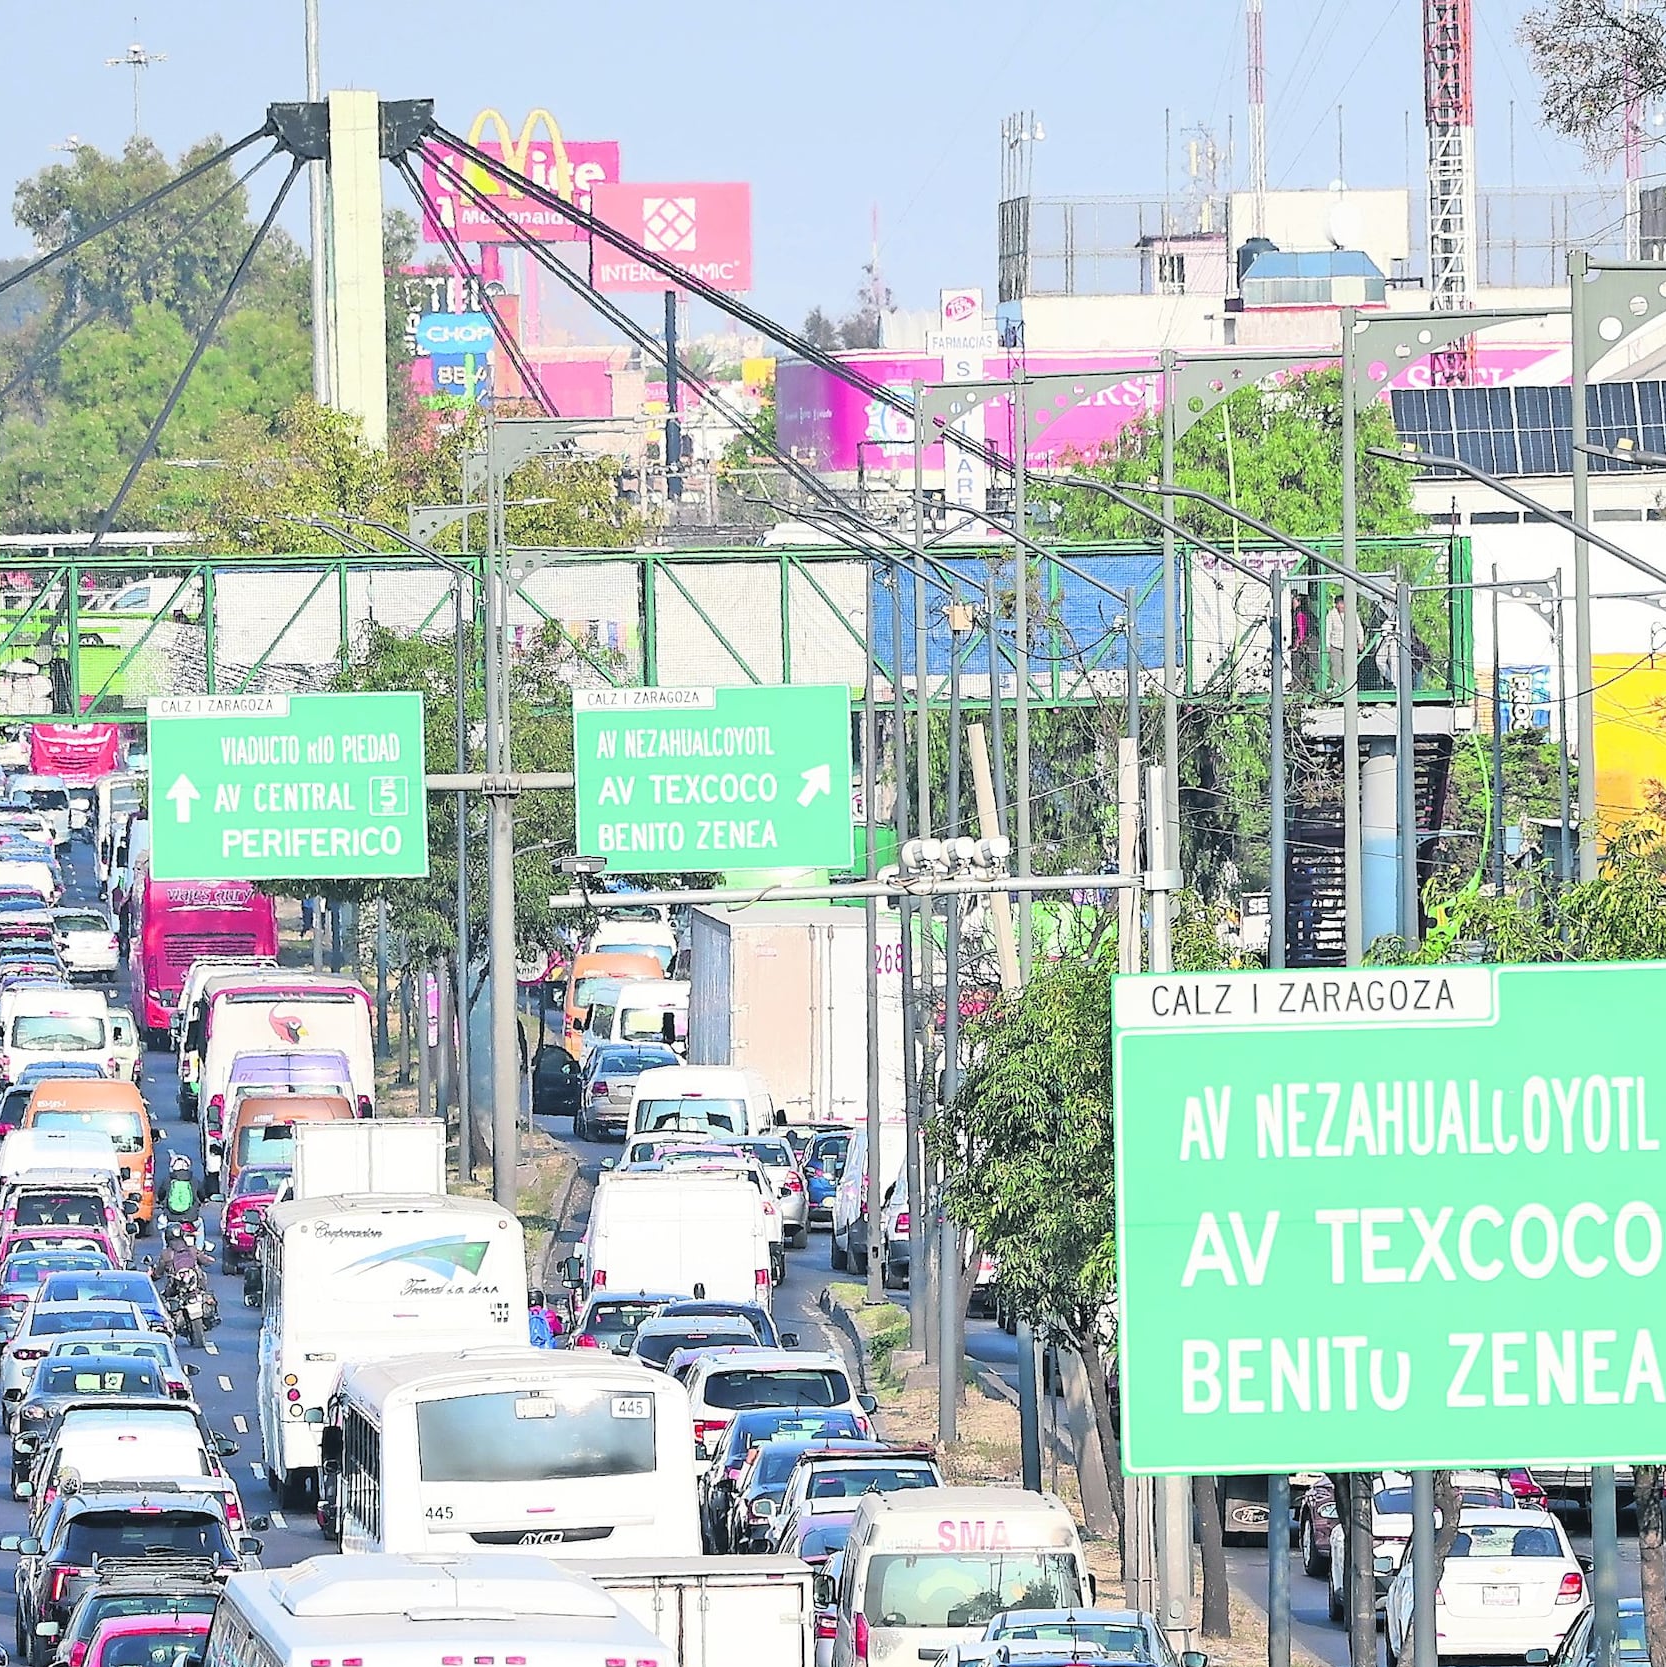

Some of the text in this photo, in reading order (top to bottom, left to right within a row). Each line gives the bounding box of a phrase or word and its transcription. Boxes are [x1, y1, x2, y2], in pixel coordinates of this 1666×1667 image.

[932, 336, 993, 350] FARMACIAS
[161, 699, 192, 713] CALZ
[208, 698, 273, 712] ZARAGOZA
[587, 692, 617, 706] CALZ
[633, 691, 700, 704] ZARAGOZA
[220, 734, 301, 766] VIADUCTO
[342, 732, 401, 763] PIEDAD
[597, 726, 775, 759] AV NEZAHUALCOYOTL
[213, 782, 398, 814] AV CENTRAL 5
[597, 772, 778, 806] AV TEXCOCO
[222, 825, 403, 859] PERIFERICO
[598, 819, 779, 852] BENITO ZENEA
[1151, 983, 1232, 1017] CALZ
[1278, 979, 1456, 1014] ZARAGOZA
[1179, 1086, 1231, 1161] AV
[1180, 1200, 1664, 1288] AV TEXCOCO
[618, 1401, 644, 1415] 445
[425, 1506, 454, 1520] 445
[937, 1519, 1012, 1553] SMA
